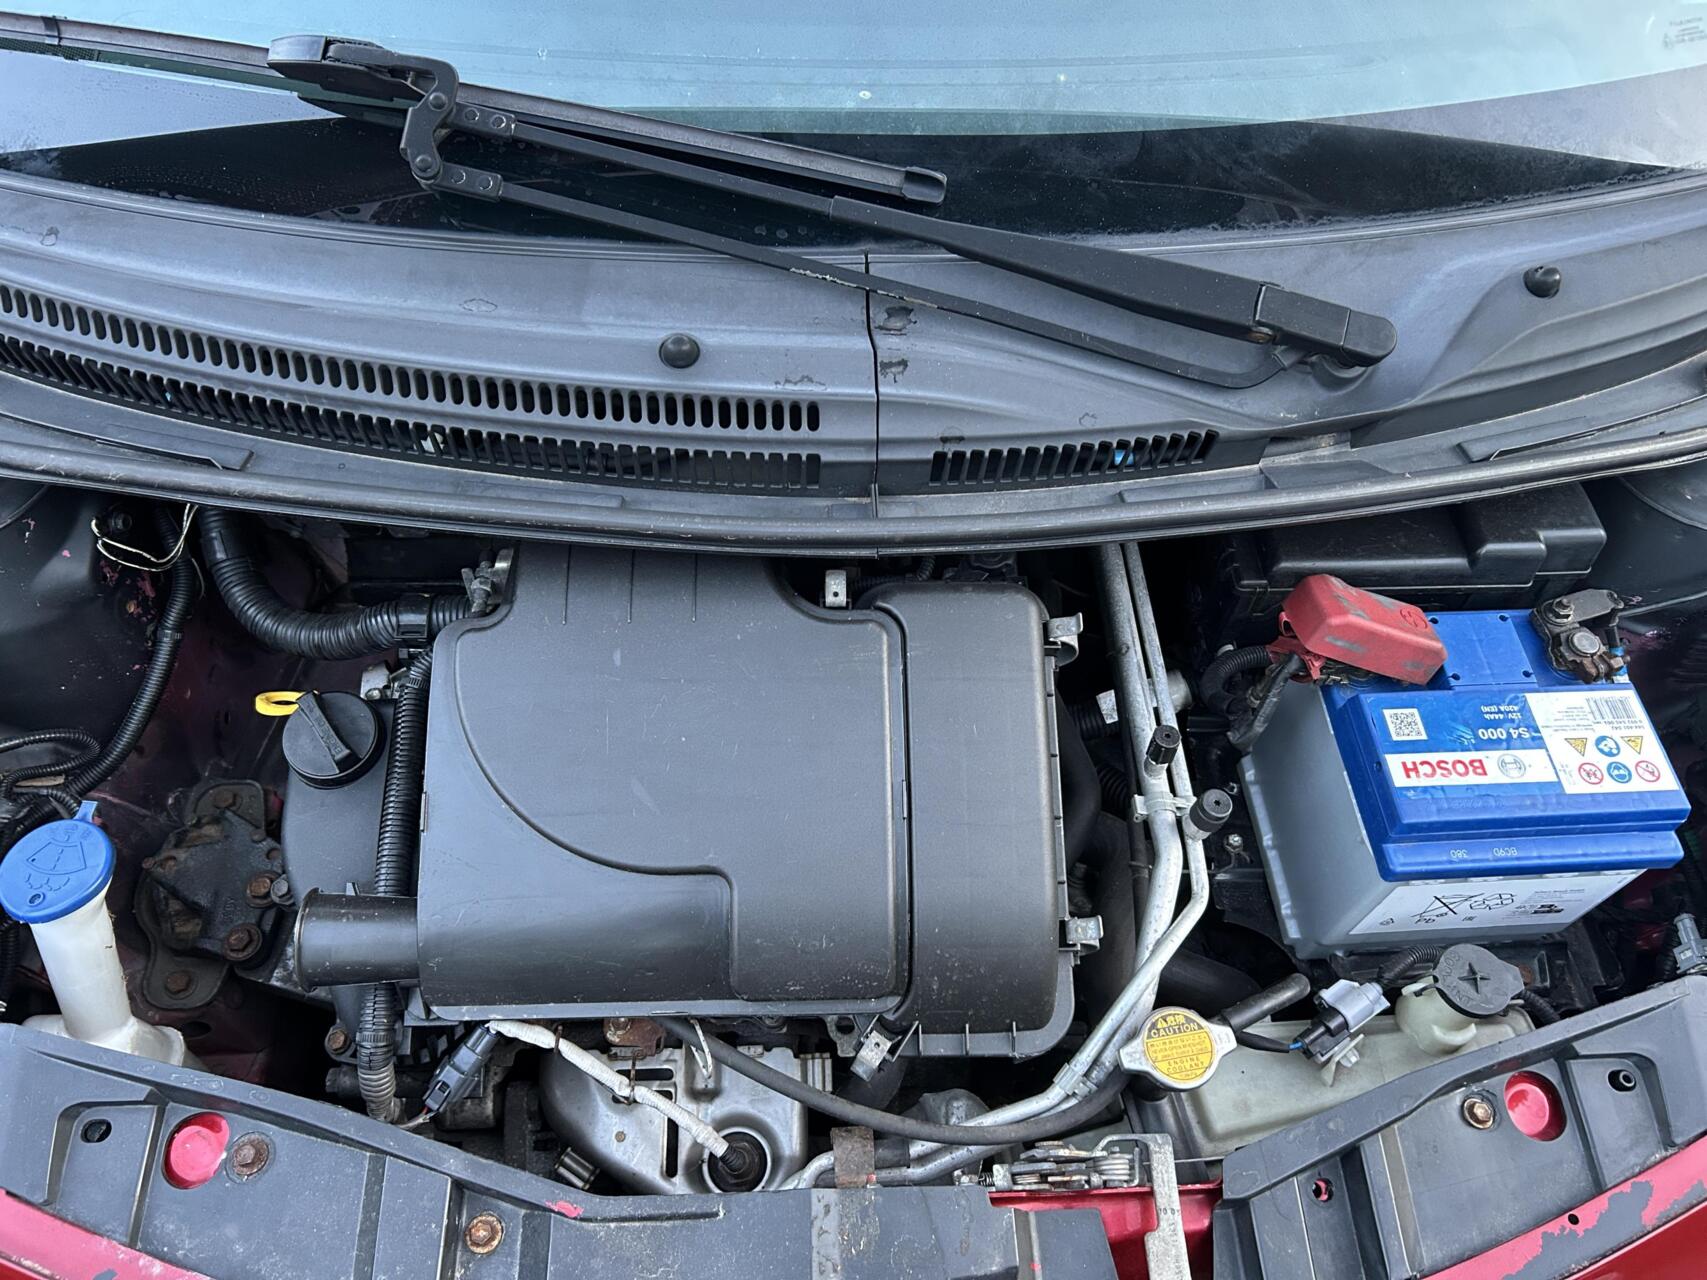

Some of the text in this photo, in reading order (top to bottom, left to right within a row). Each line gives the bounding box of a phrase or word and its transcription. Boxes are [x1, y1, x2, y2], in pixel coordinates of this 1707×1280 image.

[1484, 713, 1503, 721] 44Ah
[1478, 728, 1507, 740] 000
[1509, 727, 1530, 739] S4
[1401, 758, 1488, 779] BOSCH
[1150, 1022, 1198, 1038] CAUTION
[1166, 1061, 1205, 1072] COOLANT
[1167, 1056, 1200, 1066] ENGINE
